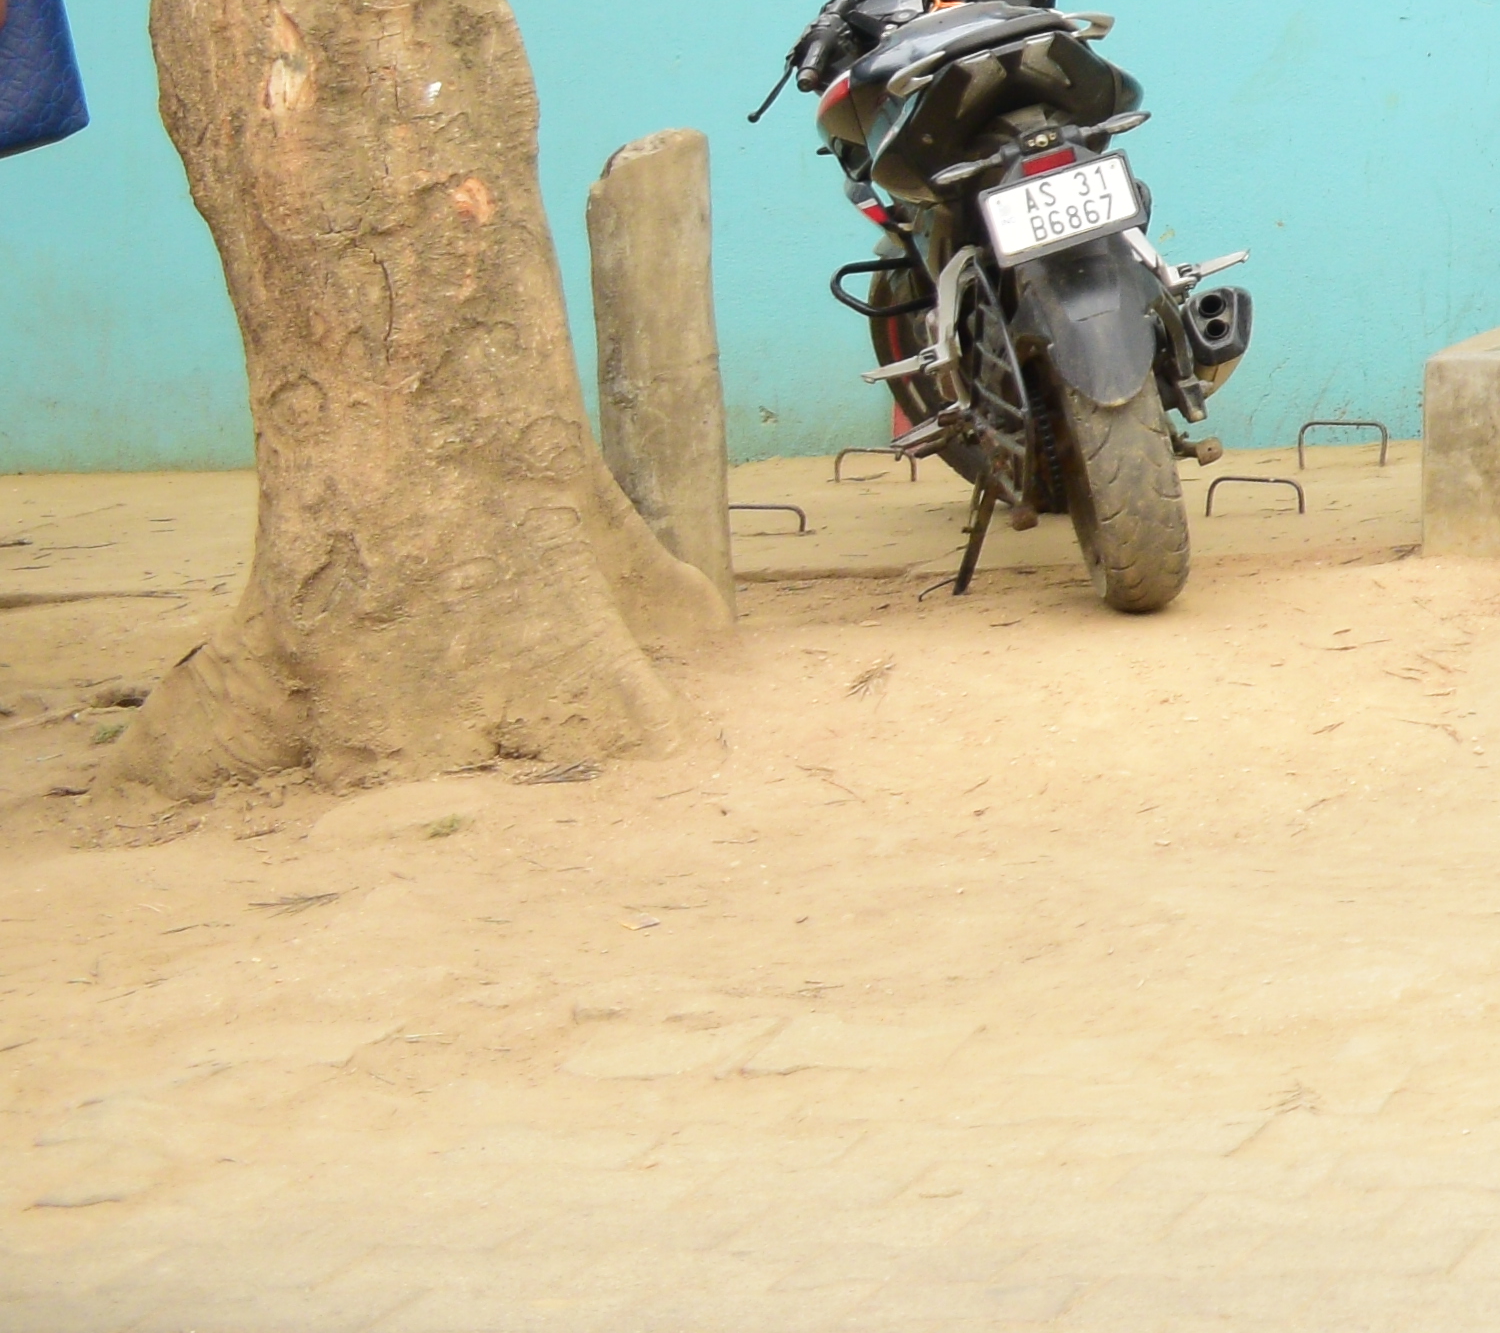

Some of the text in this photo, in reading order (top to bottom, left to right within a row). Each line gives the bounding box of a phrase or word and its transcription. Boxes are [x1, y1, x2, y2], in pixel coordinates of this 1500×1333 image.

[1025, 165, 1107, 213] AS 31
[1030, 194, 1112, 241] B6867
